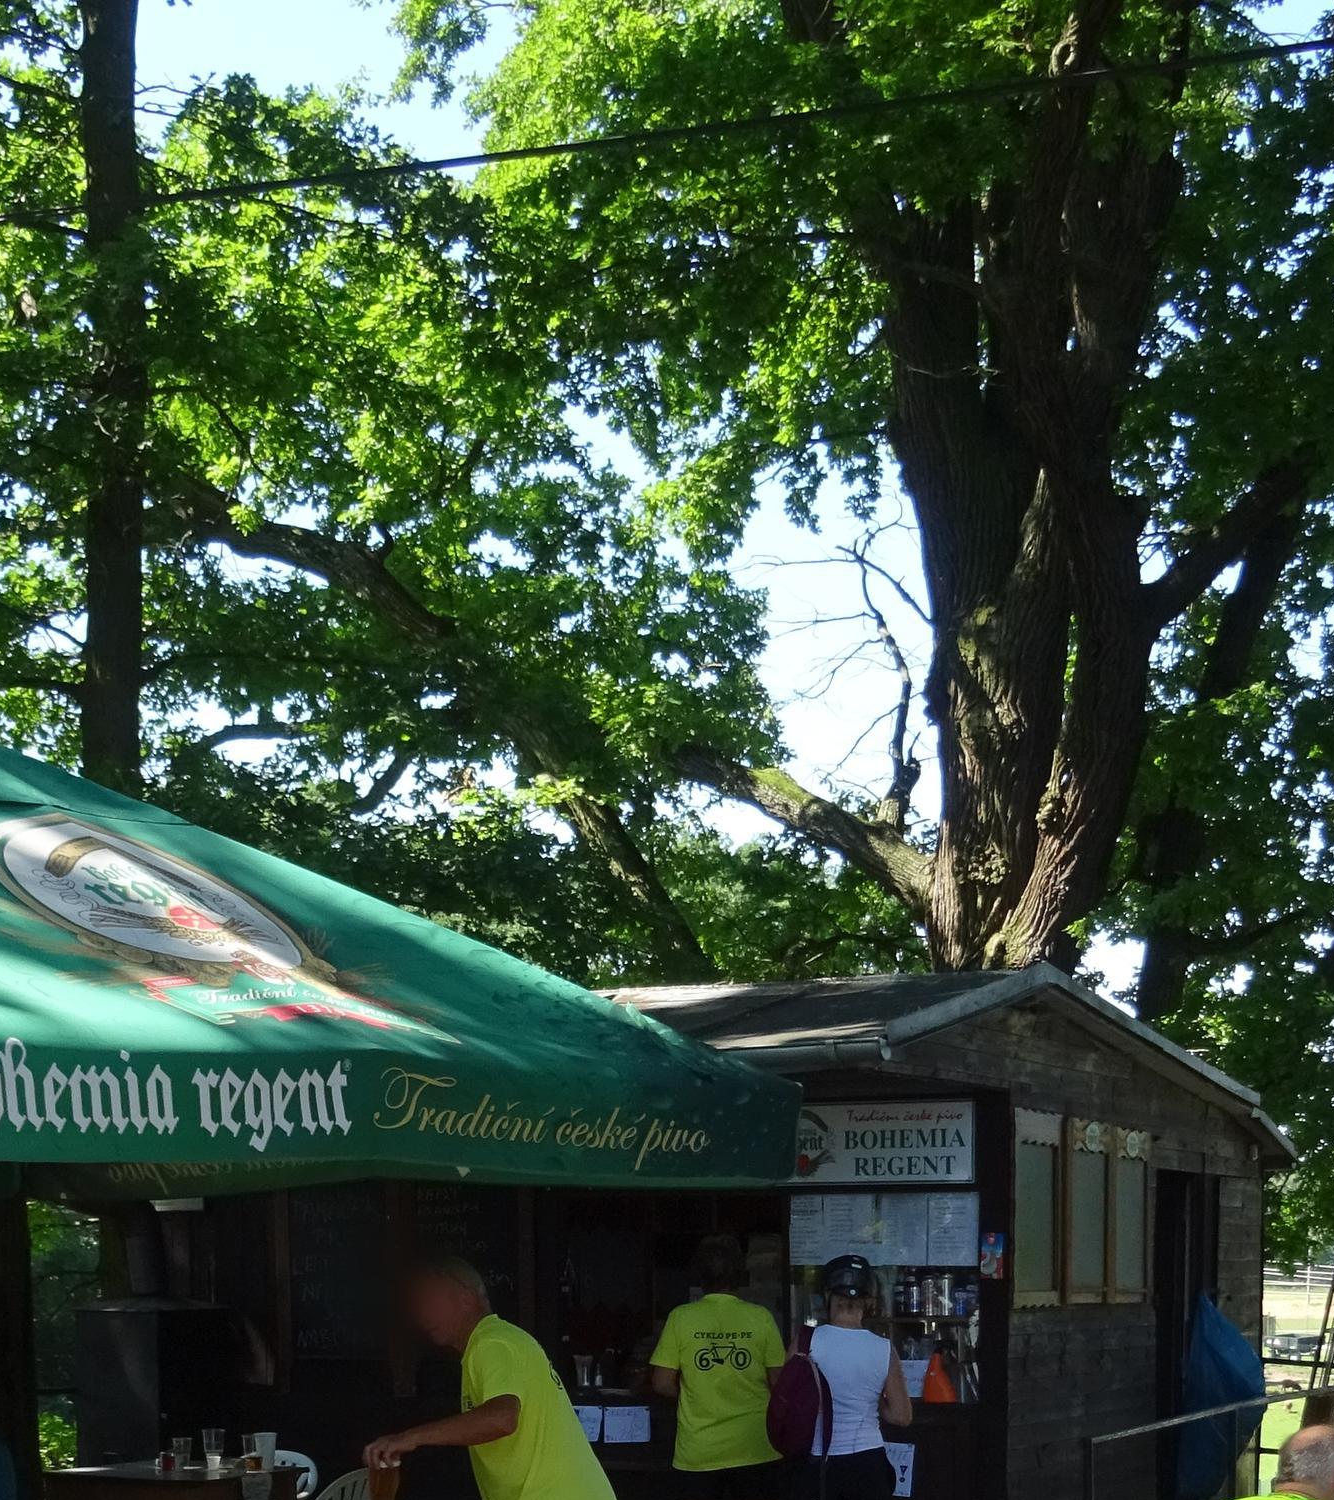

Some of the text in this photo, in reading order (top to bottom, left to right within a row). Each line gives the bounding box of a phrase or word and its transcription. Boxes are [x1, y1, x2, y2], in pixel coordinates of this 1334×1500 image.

[373, 1067, 555, 1144] Tradiční
[555, 1106, 646, 1150] české
[634, 1117, 711, 1171] pivo
[844, 1128, 966, 1151] BOHEMIA
[854, 1155, 957, 1177] REGENT
[694, 1331, 724, 1340] CYKLO
